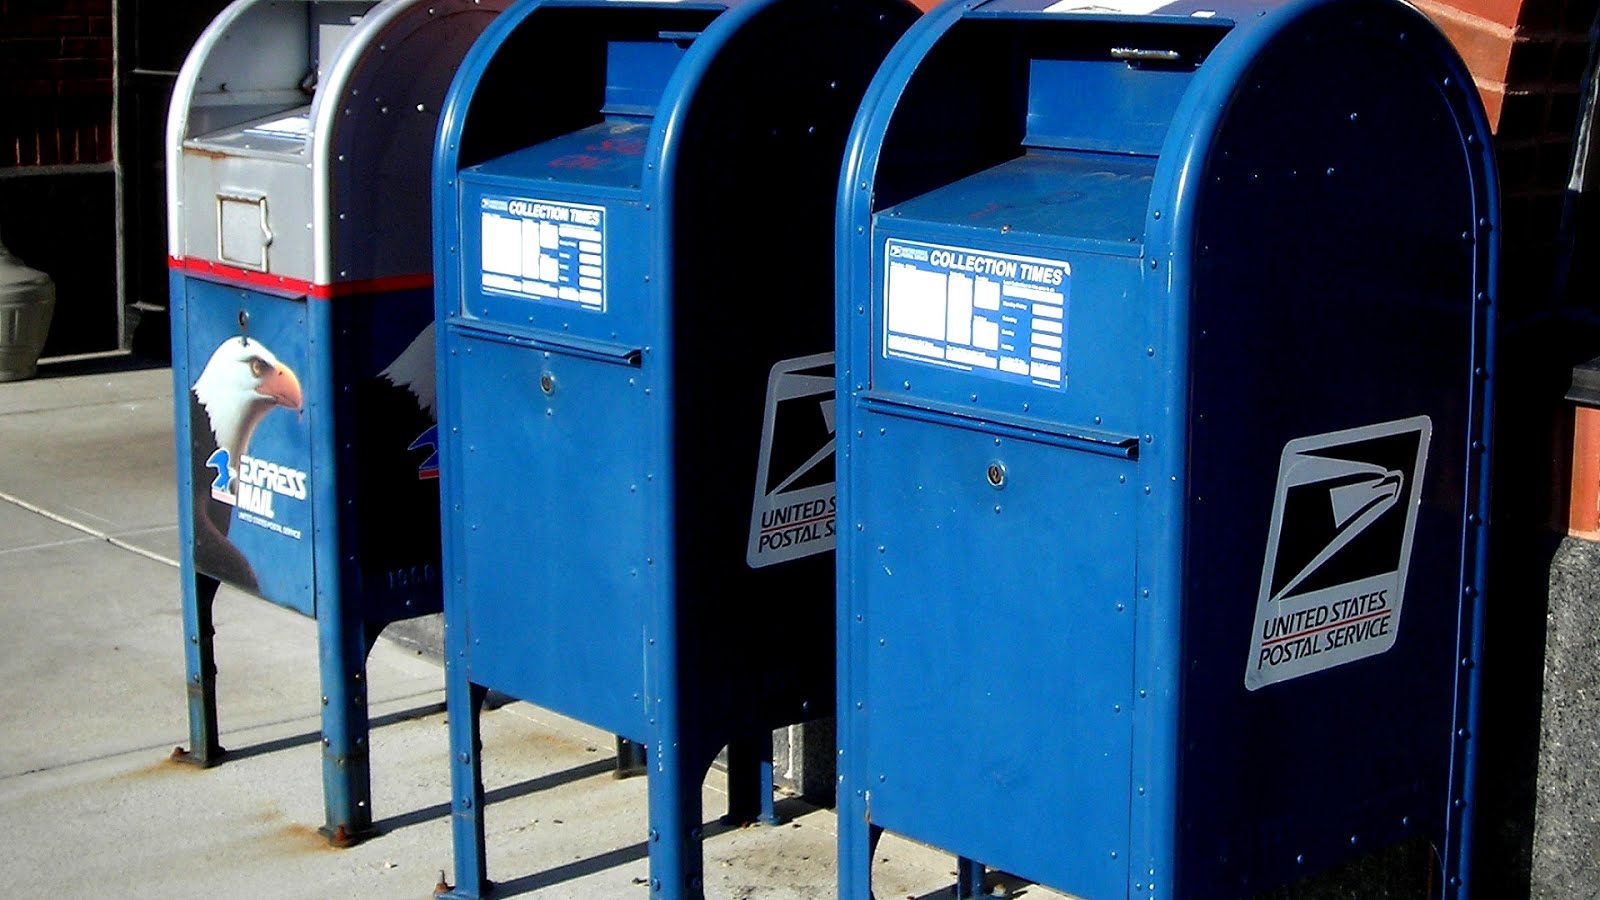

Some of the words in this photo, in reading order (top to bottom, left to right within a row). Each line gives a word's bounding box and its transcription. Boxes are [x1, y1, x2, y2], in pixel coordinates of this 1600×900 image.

[508, 200, 570, 221] COLLECTION
[569, 208, 600, 226] TIMES
[930, 250, 1017, 278] COLLECTION
[1020, 264, 1062, 286] TIMES
[240, 454, 307, 501] EXPRESS
[238, 482, 274, 519] MAIL
[761, 499, 826, 528] UNITED
[758, 523, 821, 553] POSTAL
[1263, 605, 1328, 640] UNITED
[1330, 590, 1388, 622] STATES
[1258, 634, 1322, 670] POSTAL
[1324, 615, 1391, 651] SERVICE
